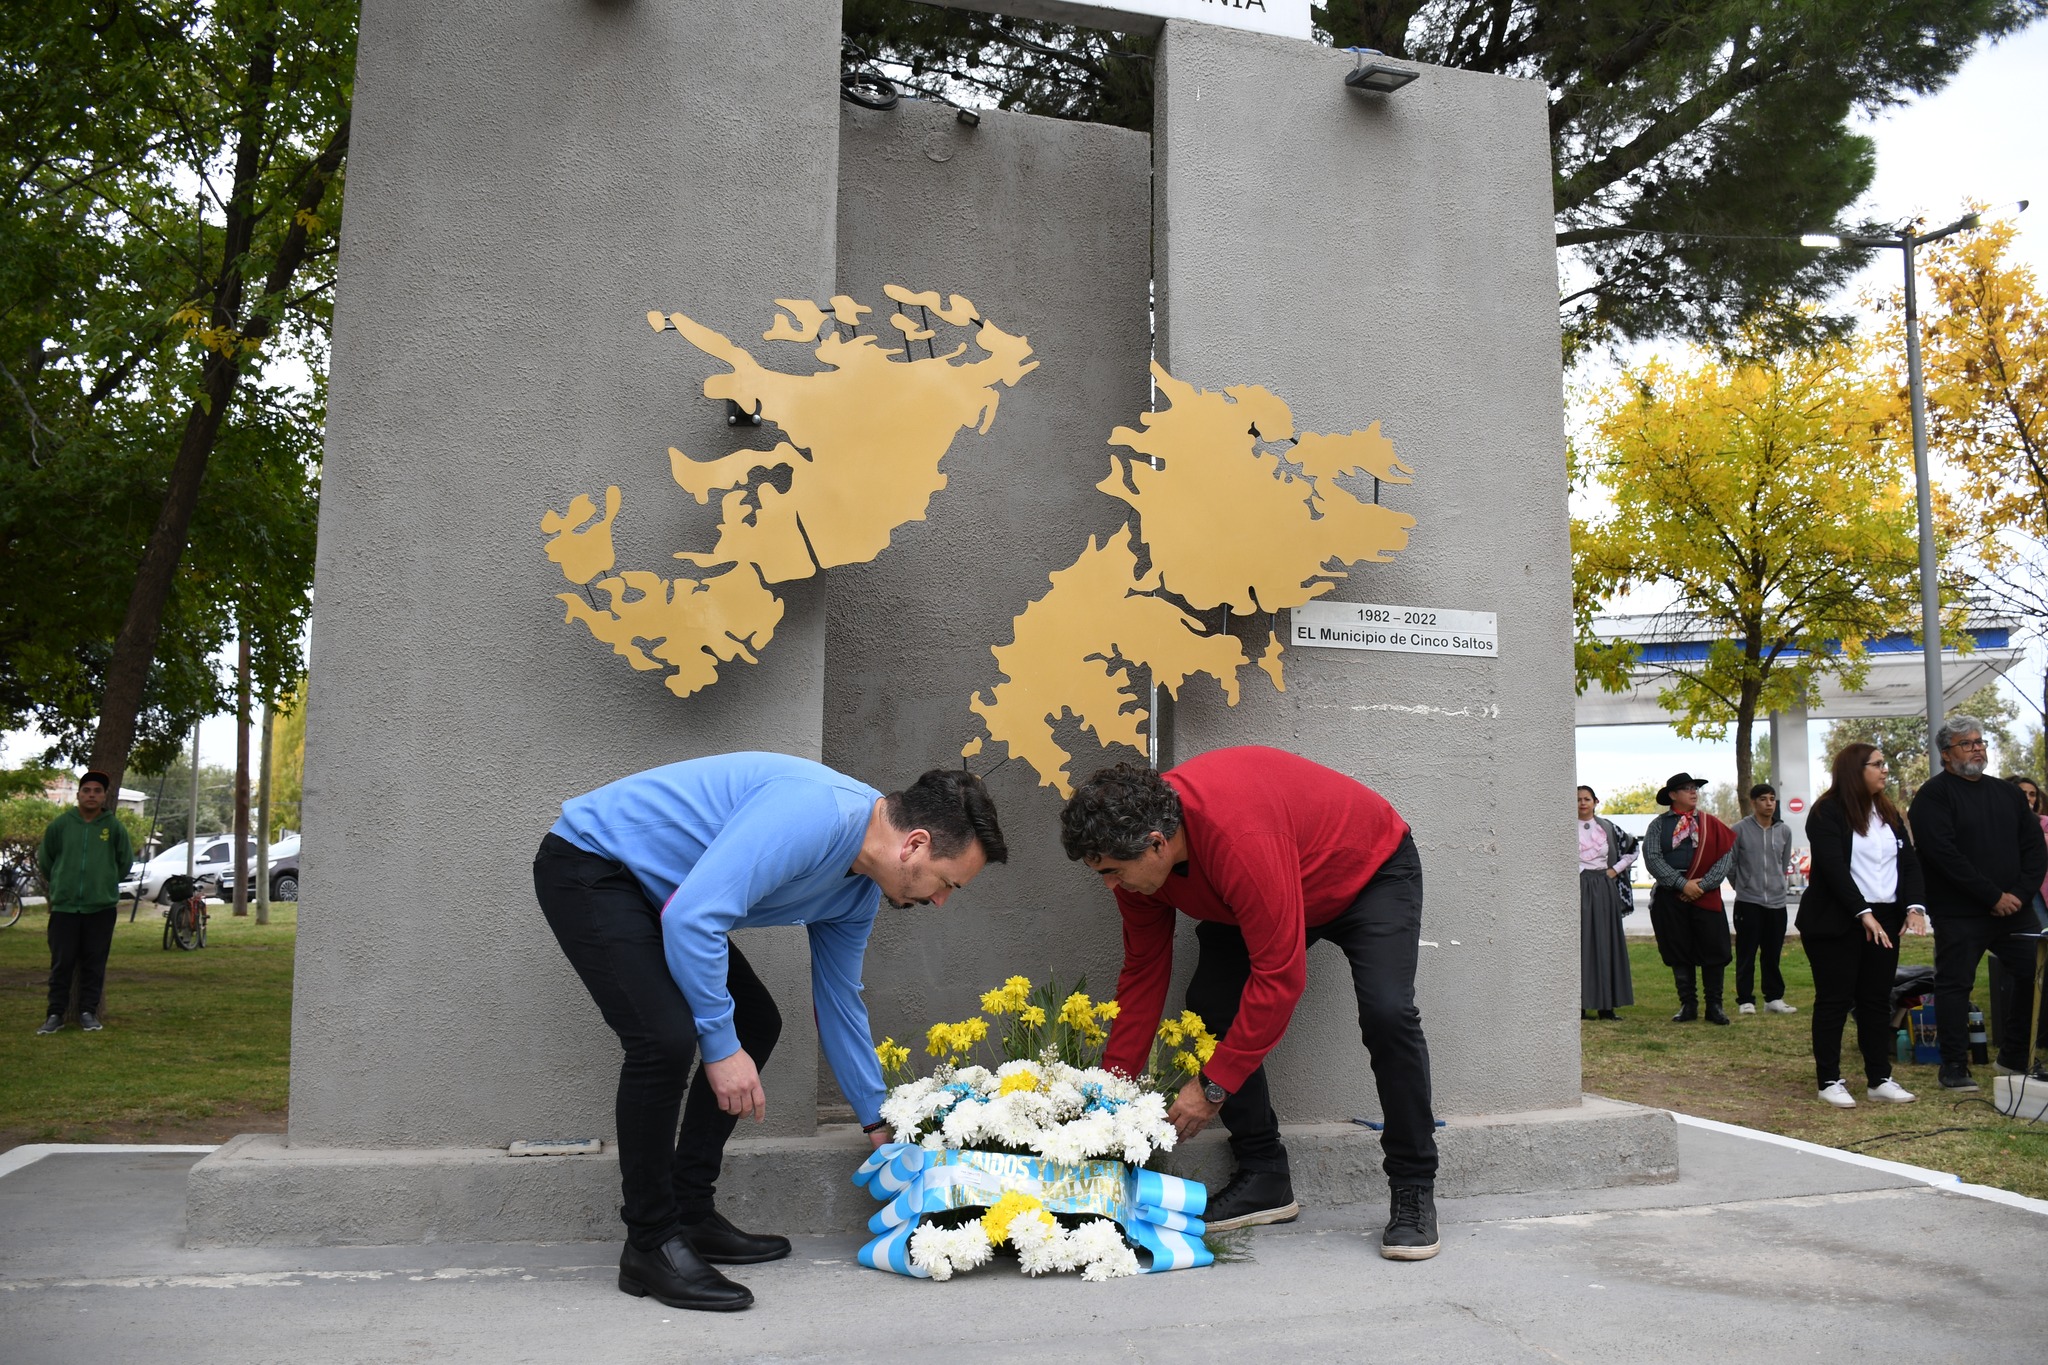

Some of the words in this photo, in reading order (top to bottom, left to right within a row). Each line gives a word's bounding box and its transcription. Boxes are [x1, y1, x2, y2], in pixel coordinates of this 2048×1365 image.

[1357, 609, 1390, 623] 1982
[1404, 612, 1437, 626] 2022
[1298, 626, 1316, 640] EL
[1320, 628, 1387, 646] Municipio
[1390, 632, 1407, 645] de
[1410, 634, 1449, 648] Cinco
[1452, 636, 1494, 650] Saltos
[933, 1150, 947, 1167] A
[957, 1150, 1031, 1181] CAIDOS
